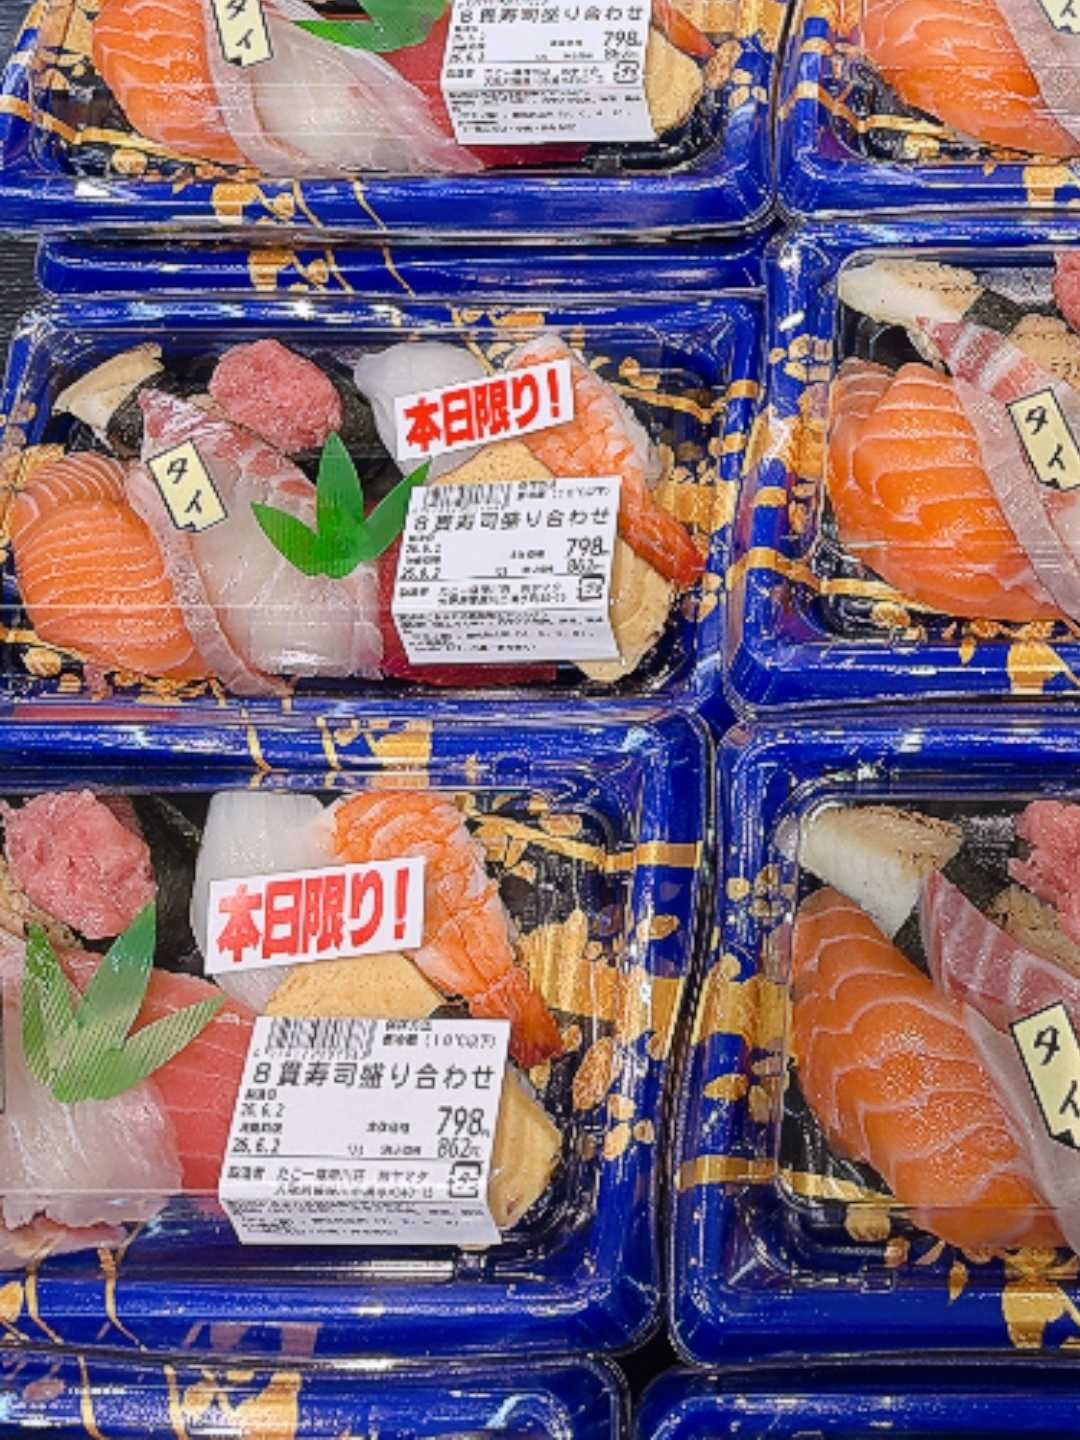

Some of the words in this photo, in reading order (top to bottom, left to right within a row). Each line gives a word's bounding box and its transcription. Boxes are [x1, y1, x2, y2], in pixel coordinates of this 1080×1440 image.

[403, 367, 562, 452] 本日限り!
[1024, 404, 1069, 472] タイ
[165, 456, 205, 516] タイ
[215, 866, 410, 963] 本日限り!
[252, 1061, 495, 1090] 8貫寿司盛り合わせ
